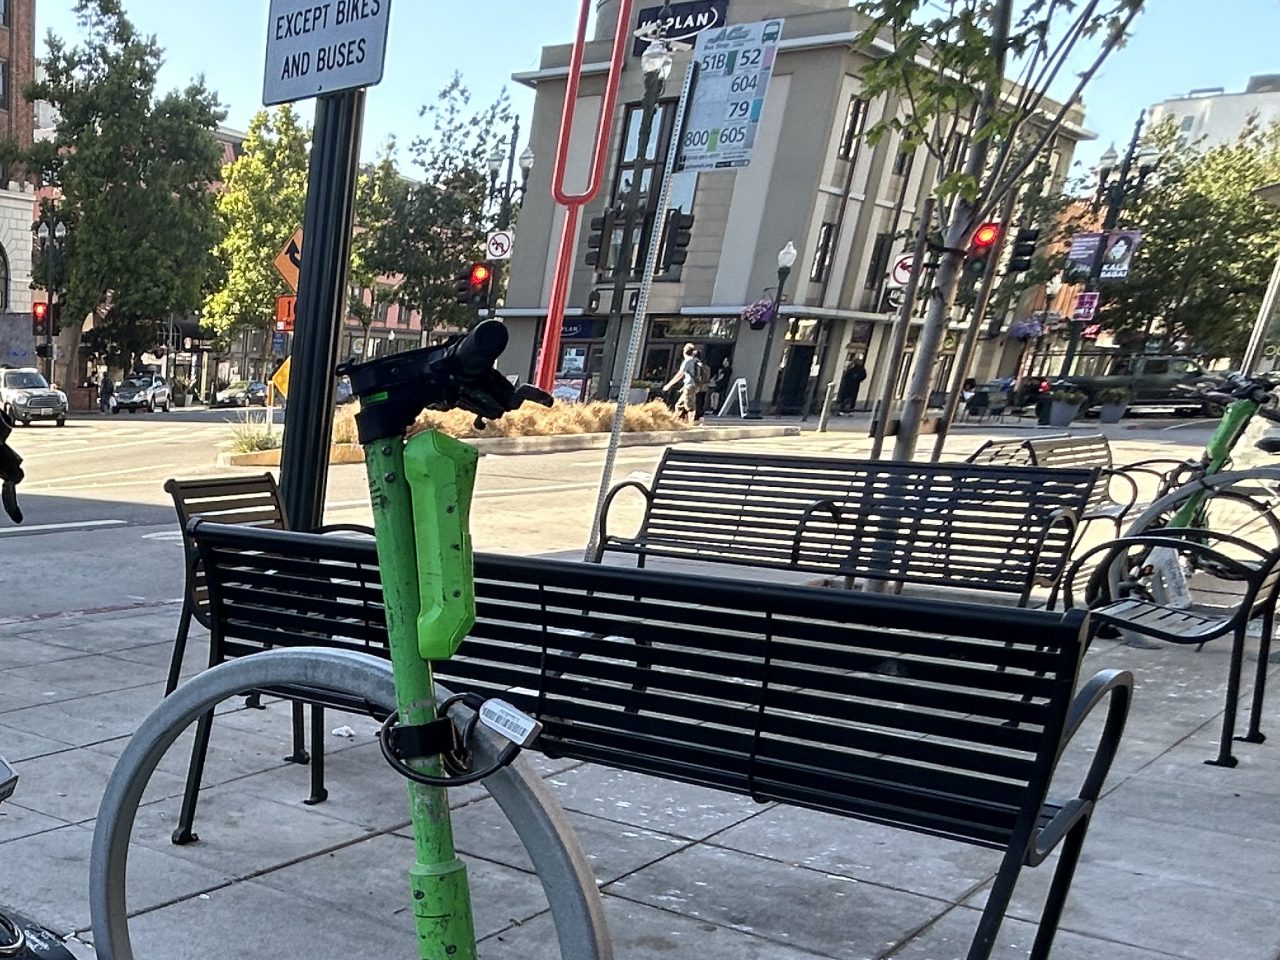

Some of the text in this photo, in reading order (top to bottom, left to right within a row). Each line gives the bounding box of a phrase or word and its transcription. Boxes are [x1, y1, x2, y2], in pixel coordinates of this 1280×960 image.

[275, 0, 381, 41] EXCEPT BIKES
[281, 38, 367, 81] AND BUSES
[701, 53, 726, 71] 51B
[740, 48, 761, 66] 52
[731, 75, 757, 92] 604
[728, 101, 749, 118] 79
[685, 130, 710, 147] 800
[720, 127, 747, 144] 605
